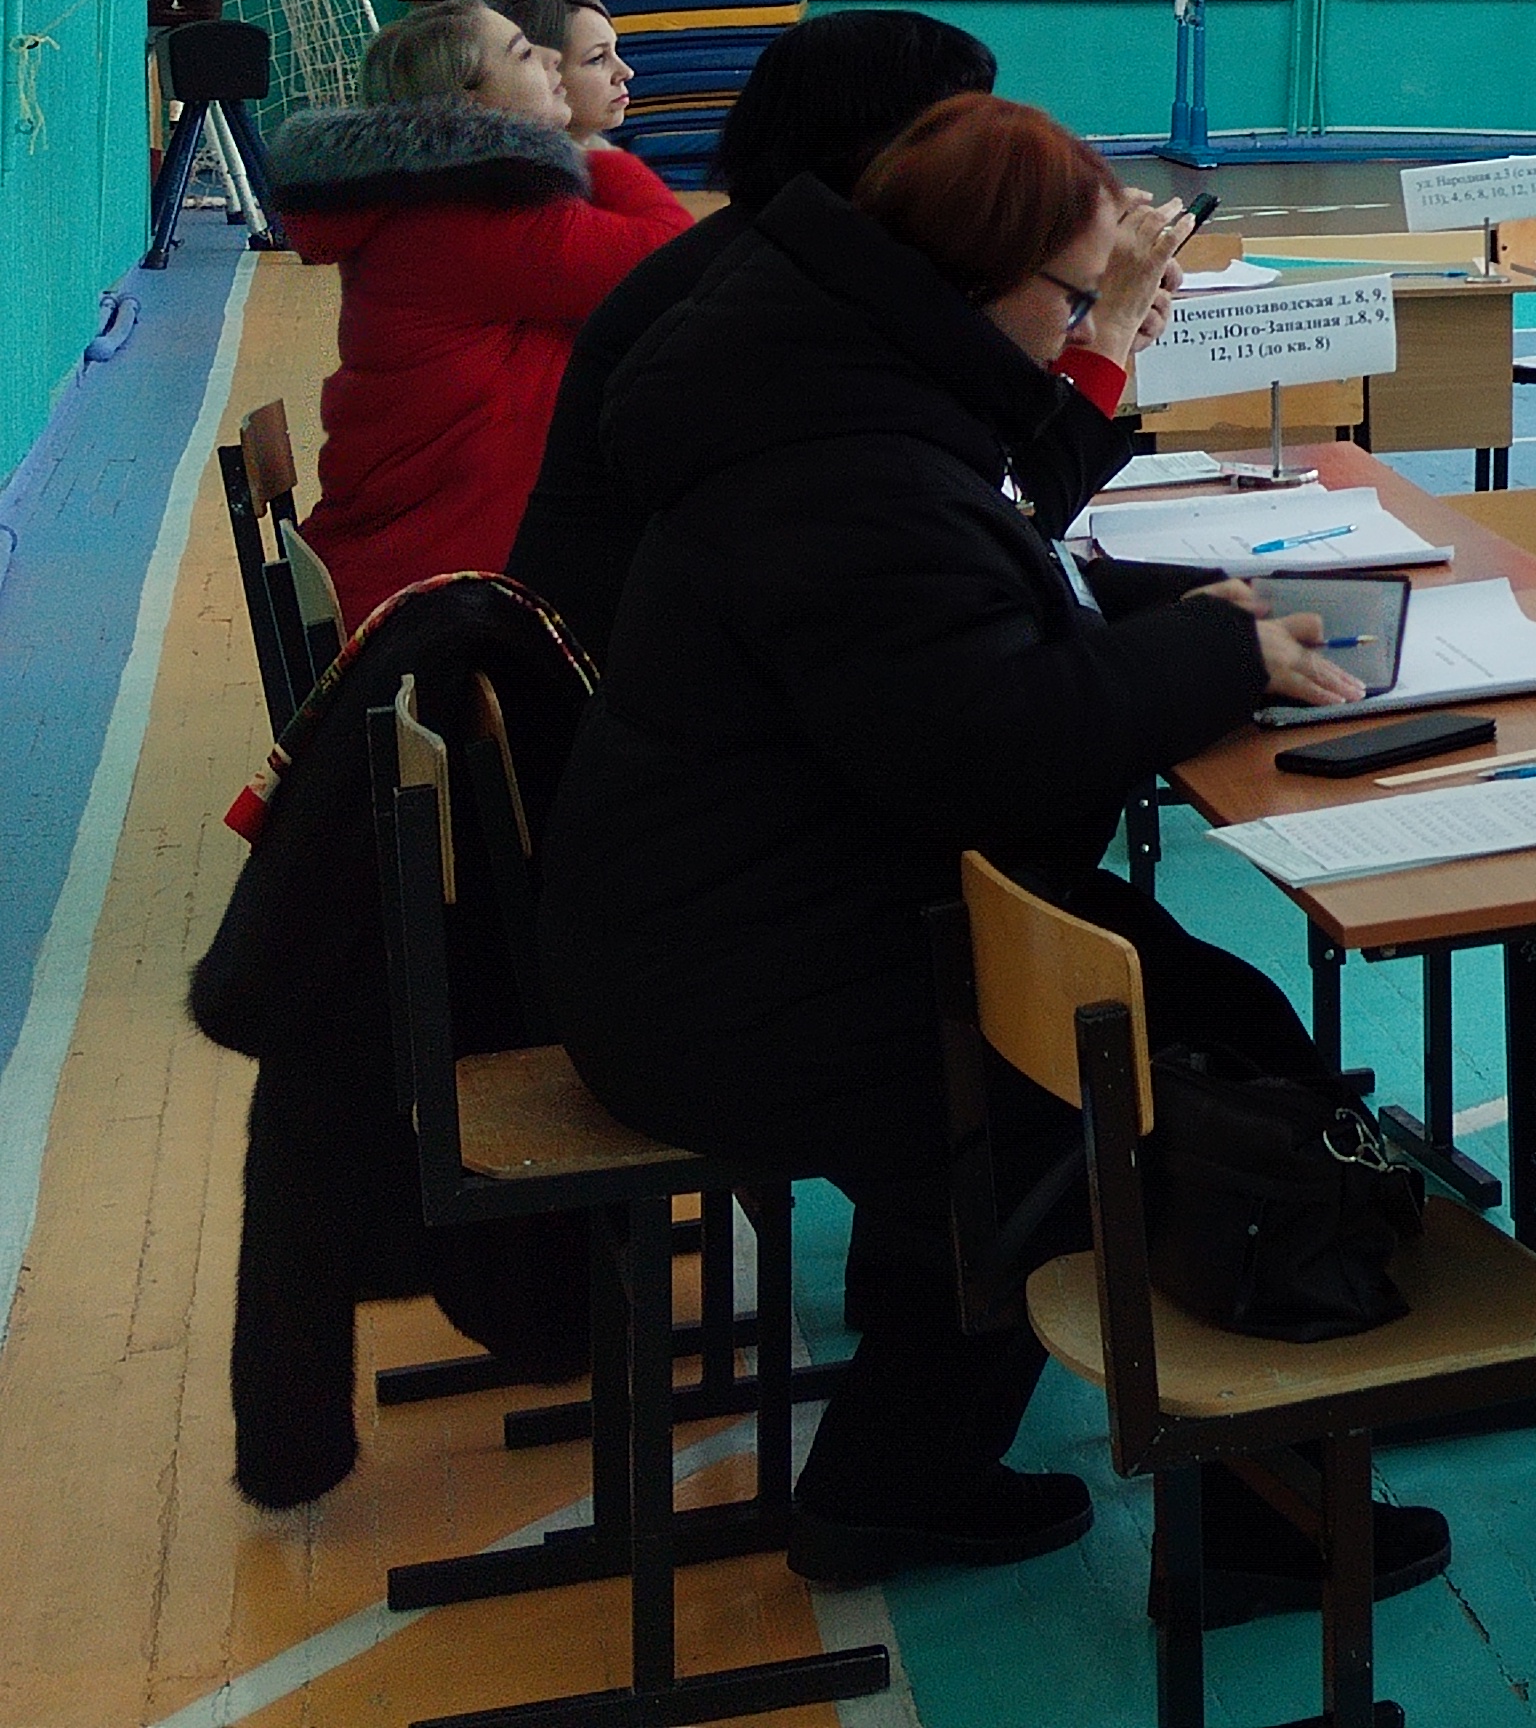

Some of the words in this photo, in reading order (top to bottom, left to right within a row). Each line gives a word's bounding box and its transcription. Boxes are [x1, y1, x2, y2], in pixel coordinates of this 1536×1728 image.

[1173, 296, 1333, 324] Цементнозаводская
[1354, 289, 1370, 305] 8,
[1172, 328, 1196, 345] 12,
[1209, 346, 1233, 363] 12,
[1237, 343, 1254, 360] 13
[1258, 343, 1283, 359] (до
[1286, 339, 1312, 354] кв.
[1314, 335, 1332, 353] 8)
